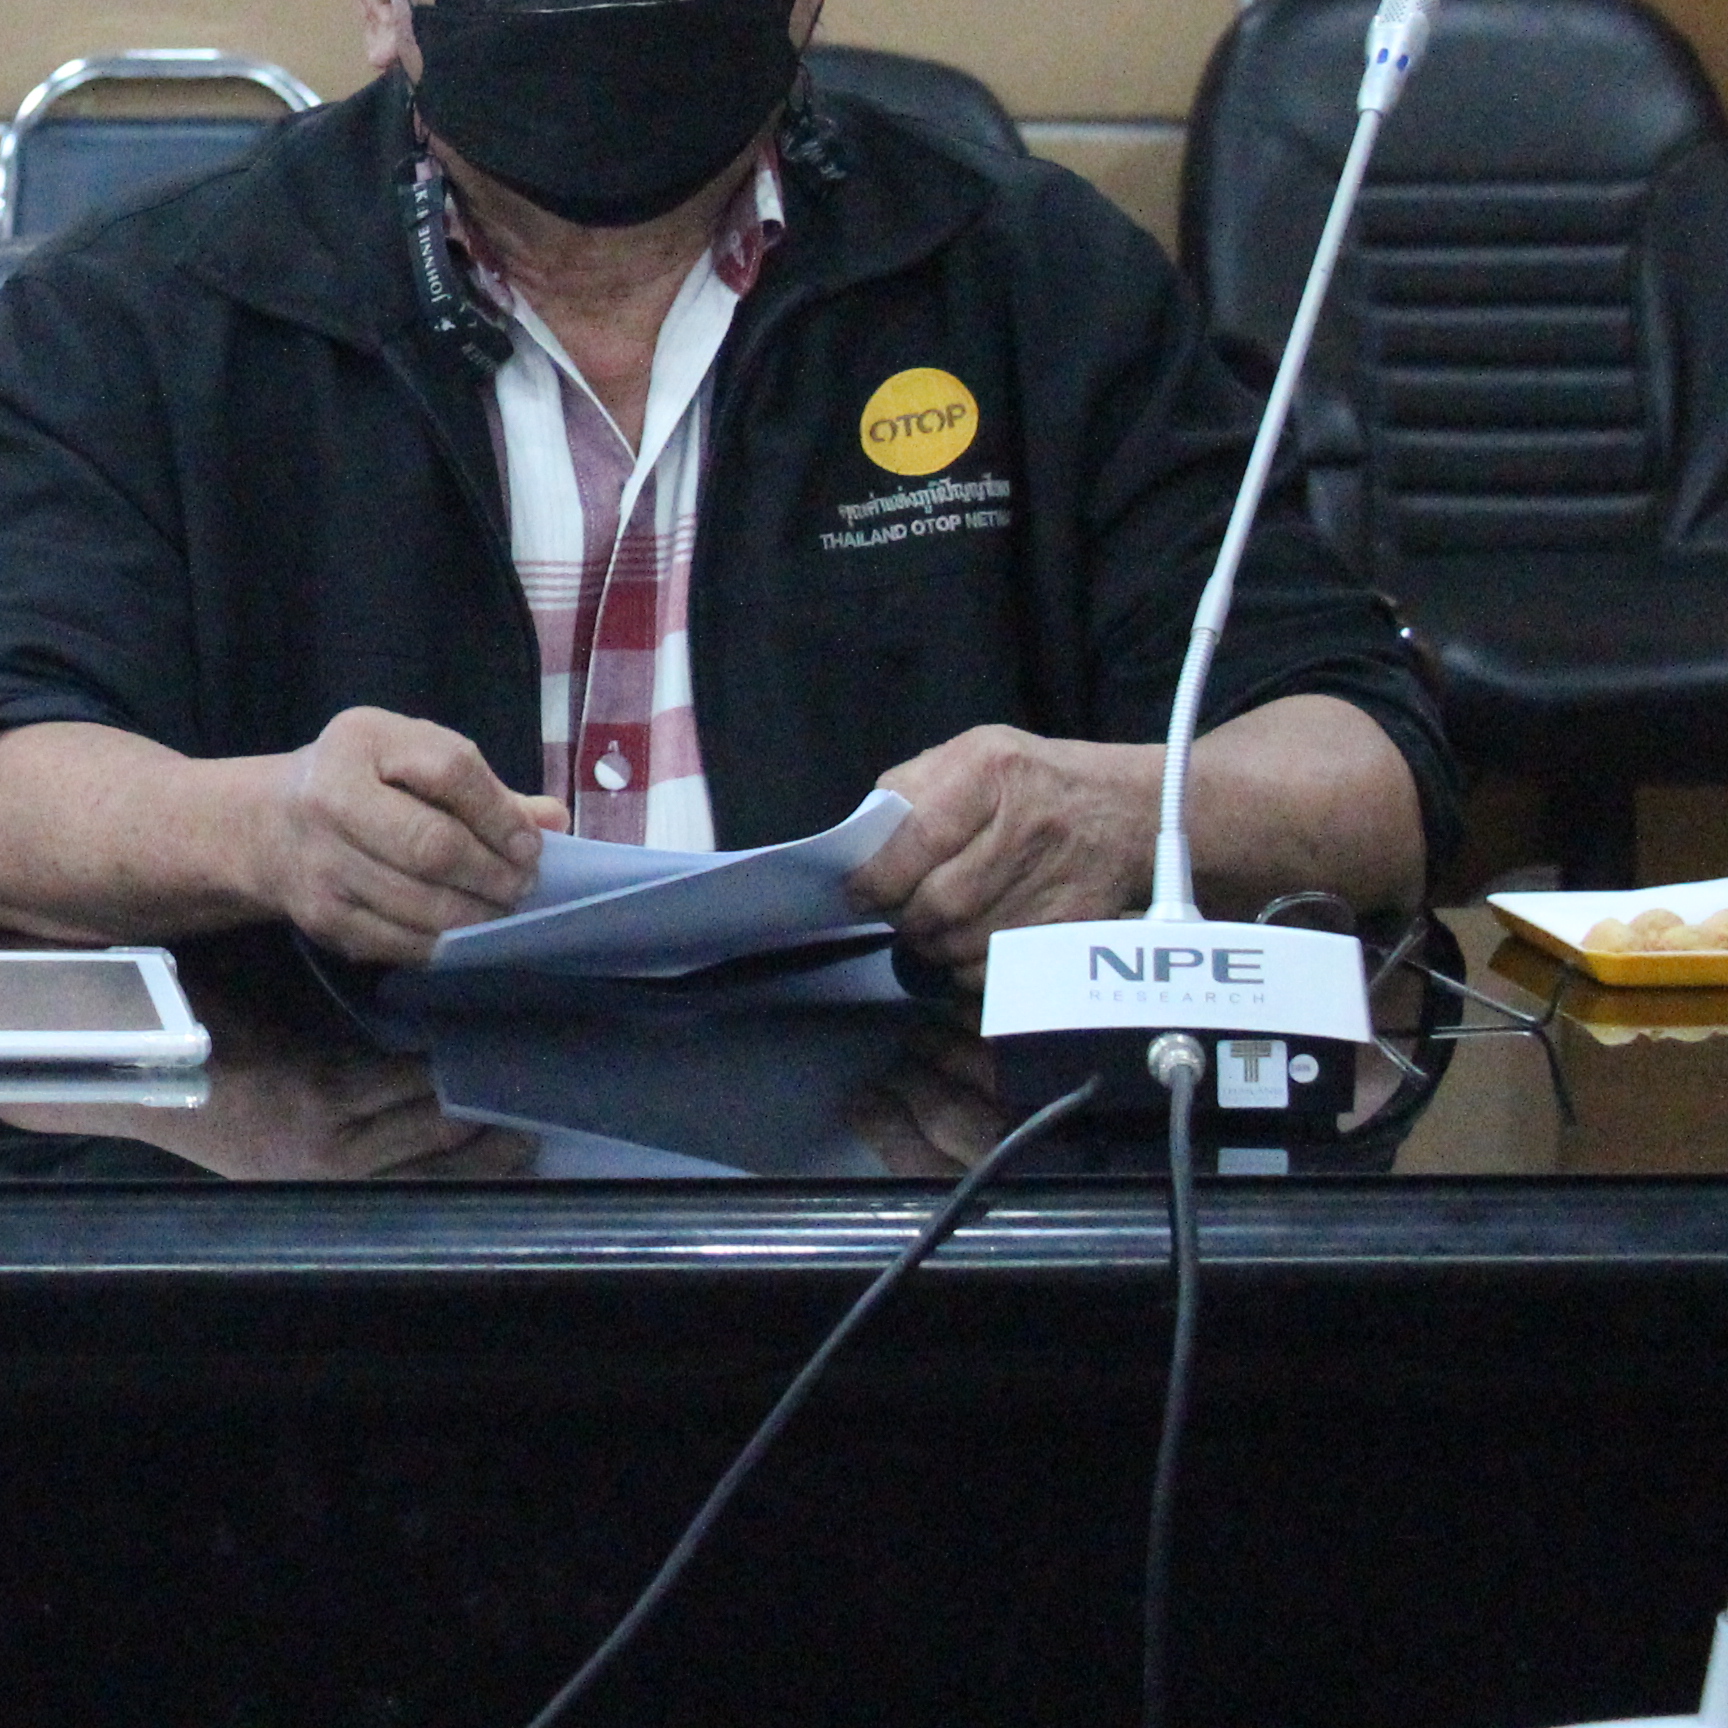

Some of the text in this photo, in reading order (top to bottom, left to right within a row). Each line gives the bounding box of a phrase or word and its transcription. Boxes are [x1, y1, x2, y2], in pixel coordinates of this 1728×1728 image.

[417, 225, 452, 303] JOHNNIE
[869, 403, 967, 443] OTOP
[819, 523, 908, 550] THAILAND
[911, 513, 962, 536] OTOP
[1089, 945, 1265, 984] NPE
[1089, 989, 1265, 1004] RESEARCH
